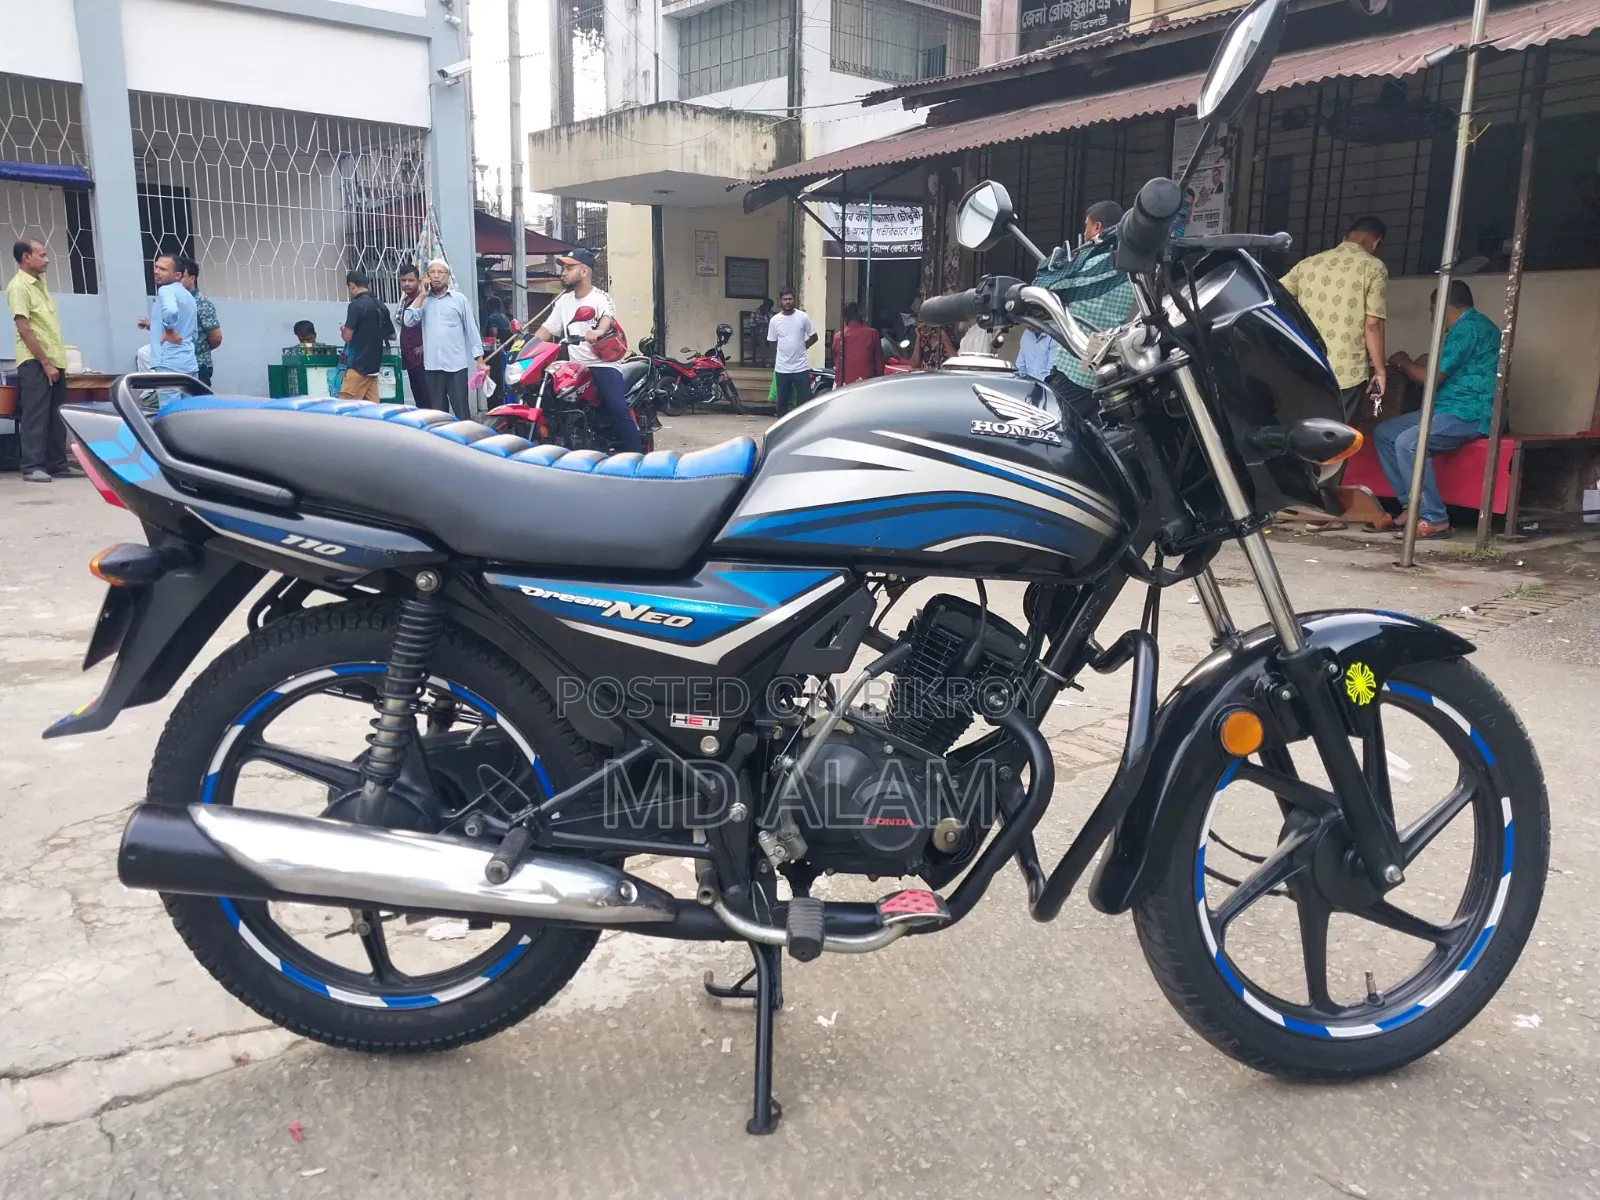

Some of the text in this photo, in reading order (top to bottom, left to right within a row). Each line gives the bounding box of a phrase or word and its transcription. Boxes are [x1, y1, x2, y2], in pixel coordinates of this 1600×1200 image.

[1021, 4, 1047, 28] জেলা
[970, 419, 1062, 444] HONDA
[280, 534, 346, 555] 110
[518, 584, 613, 609] Dream
[672, 715, 718, 726] HET
[865, 816, 914, 826] HONDA
